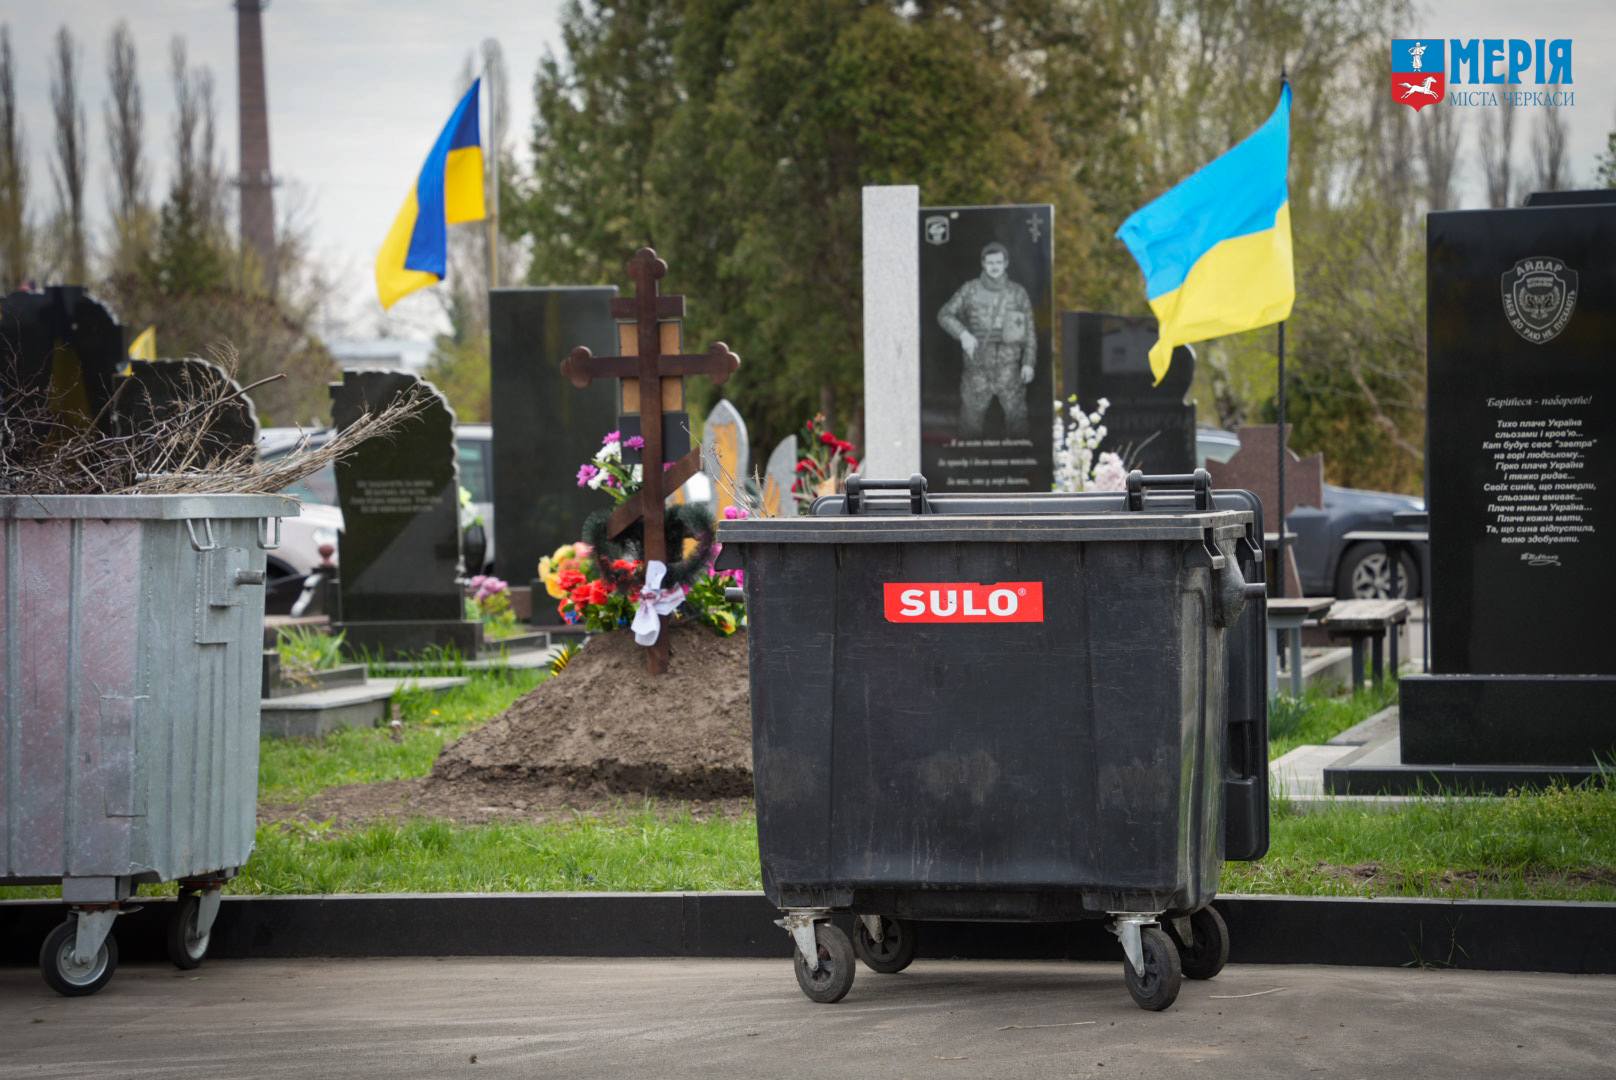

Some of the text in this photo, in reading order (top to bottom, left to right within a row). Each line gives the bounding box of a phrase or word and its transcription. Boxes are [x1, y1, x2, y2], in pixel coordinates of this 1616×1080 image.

[1497, 418, 1583, 428] Тихо плаче Україна
[1495, 430, 1538, 439] сльозами
[1482, 441, 1502, 449] Кат
[1503, 440, 1530, 450] будує
[1506, 451, 1526, 460] горі
[1495, 461, 1584, 471] Гірко плаче Україна
[1483, 482, 1509, 492] Своїх
[1538, 483, 1553, 492] що
[1497, 493, 1540, 502] сльозами
[1487, 503, 1515, 512] Плаче
[1516, 504, 1548, 512] ненька
[1497, 514, 1524, 523] Плаче
[1500, 525, 1515, 533] що
[1516, 525, 1538, 533] сина
